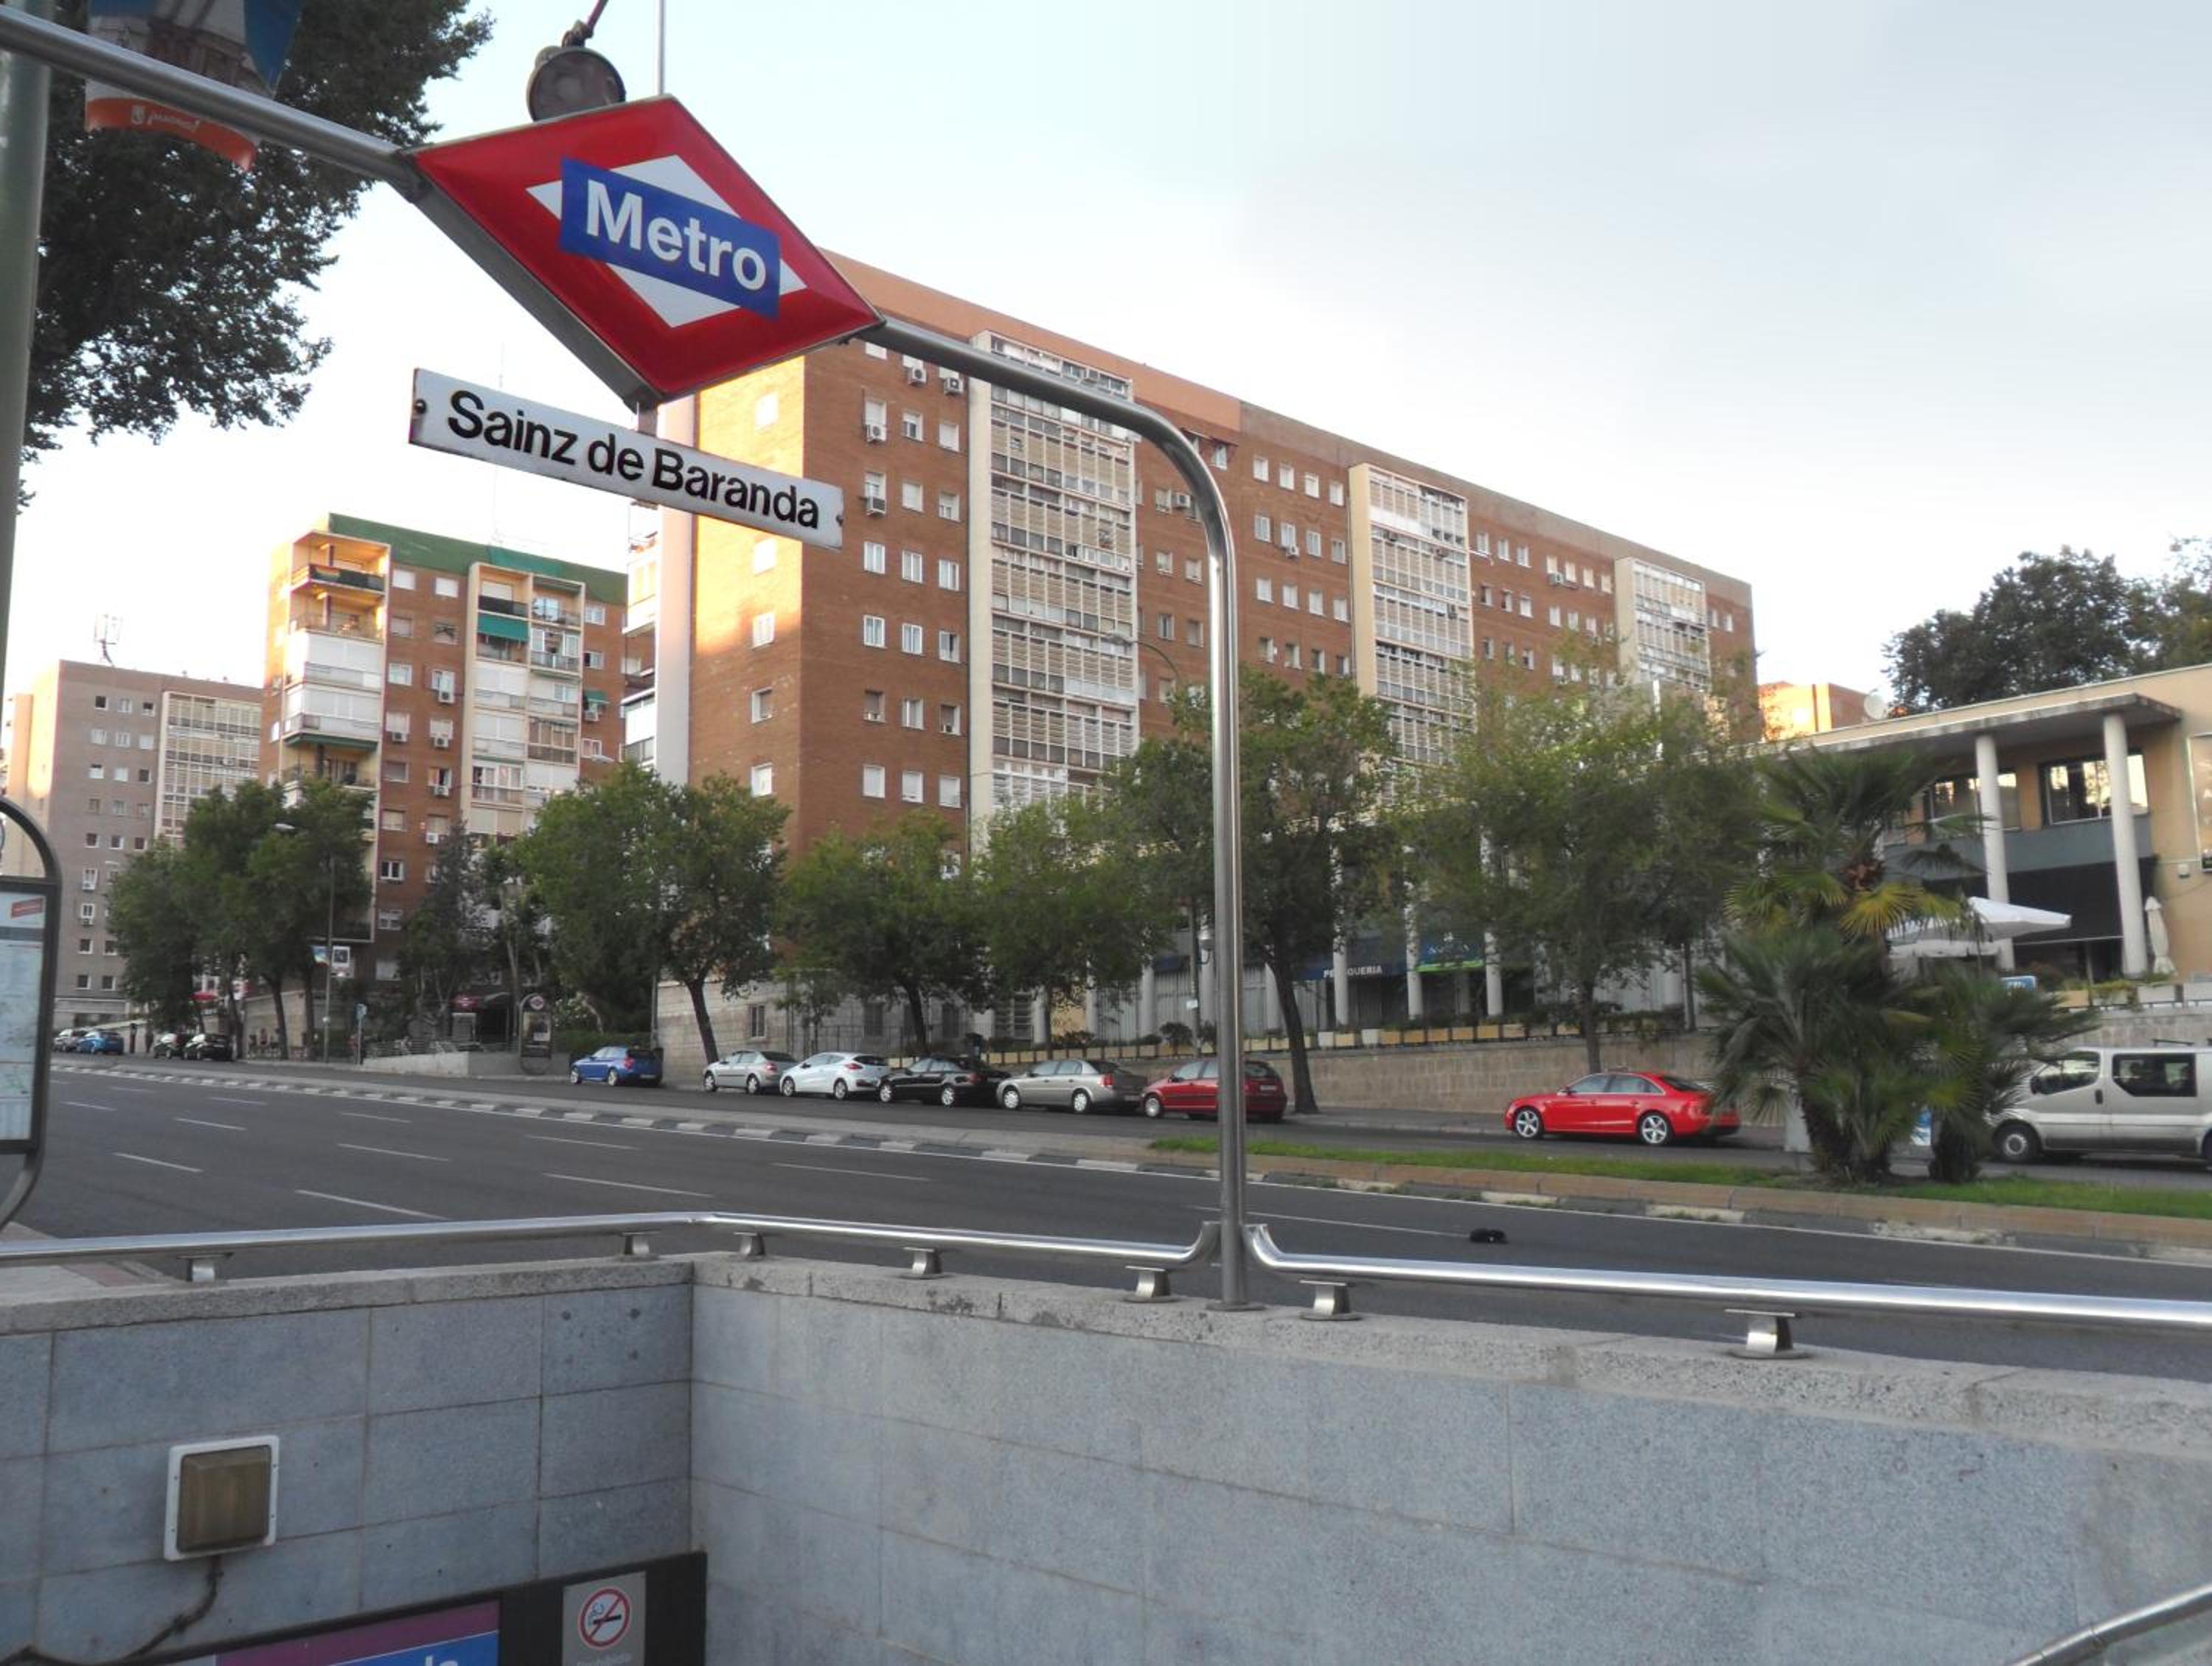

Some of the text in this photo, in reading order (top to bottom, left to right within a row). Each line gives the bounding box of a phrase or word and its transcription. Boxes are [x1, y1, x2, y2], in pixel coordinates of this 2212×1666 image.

[586, 178, 766, 290] Metro
[448, 391, 818, 529] Sainz de Baranda
[1324, 965, 1382, 978] PEQUERIA
